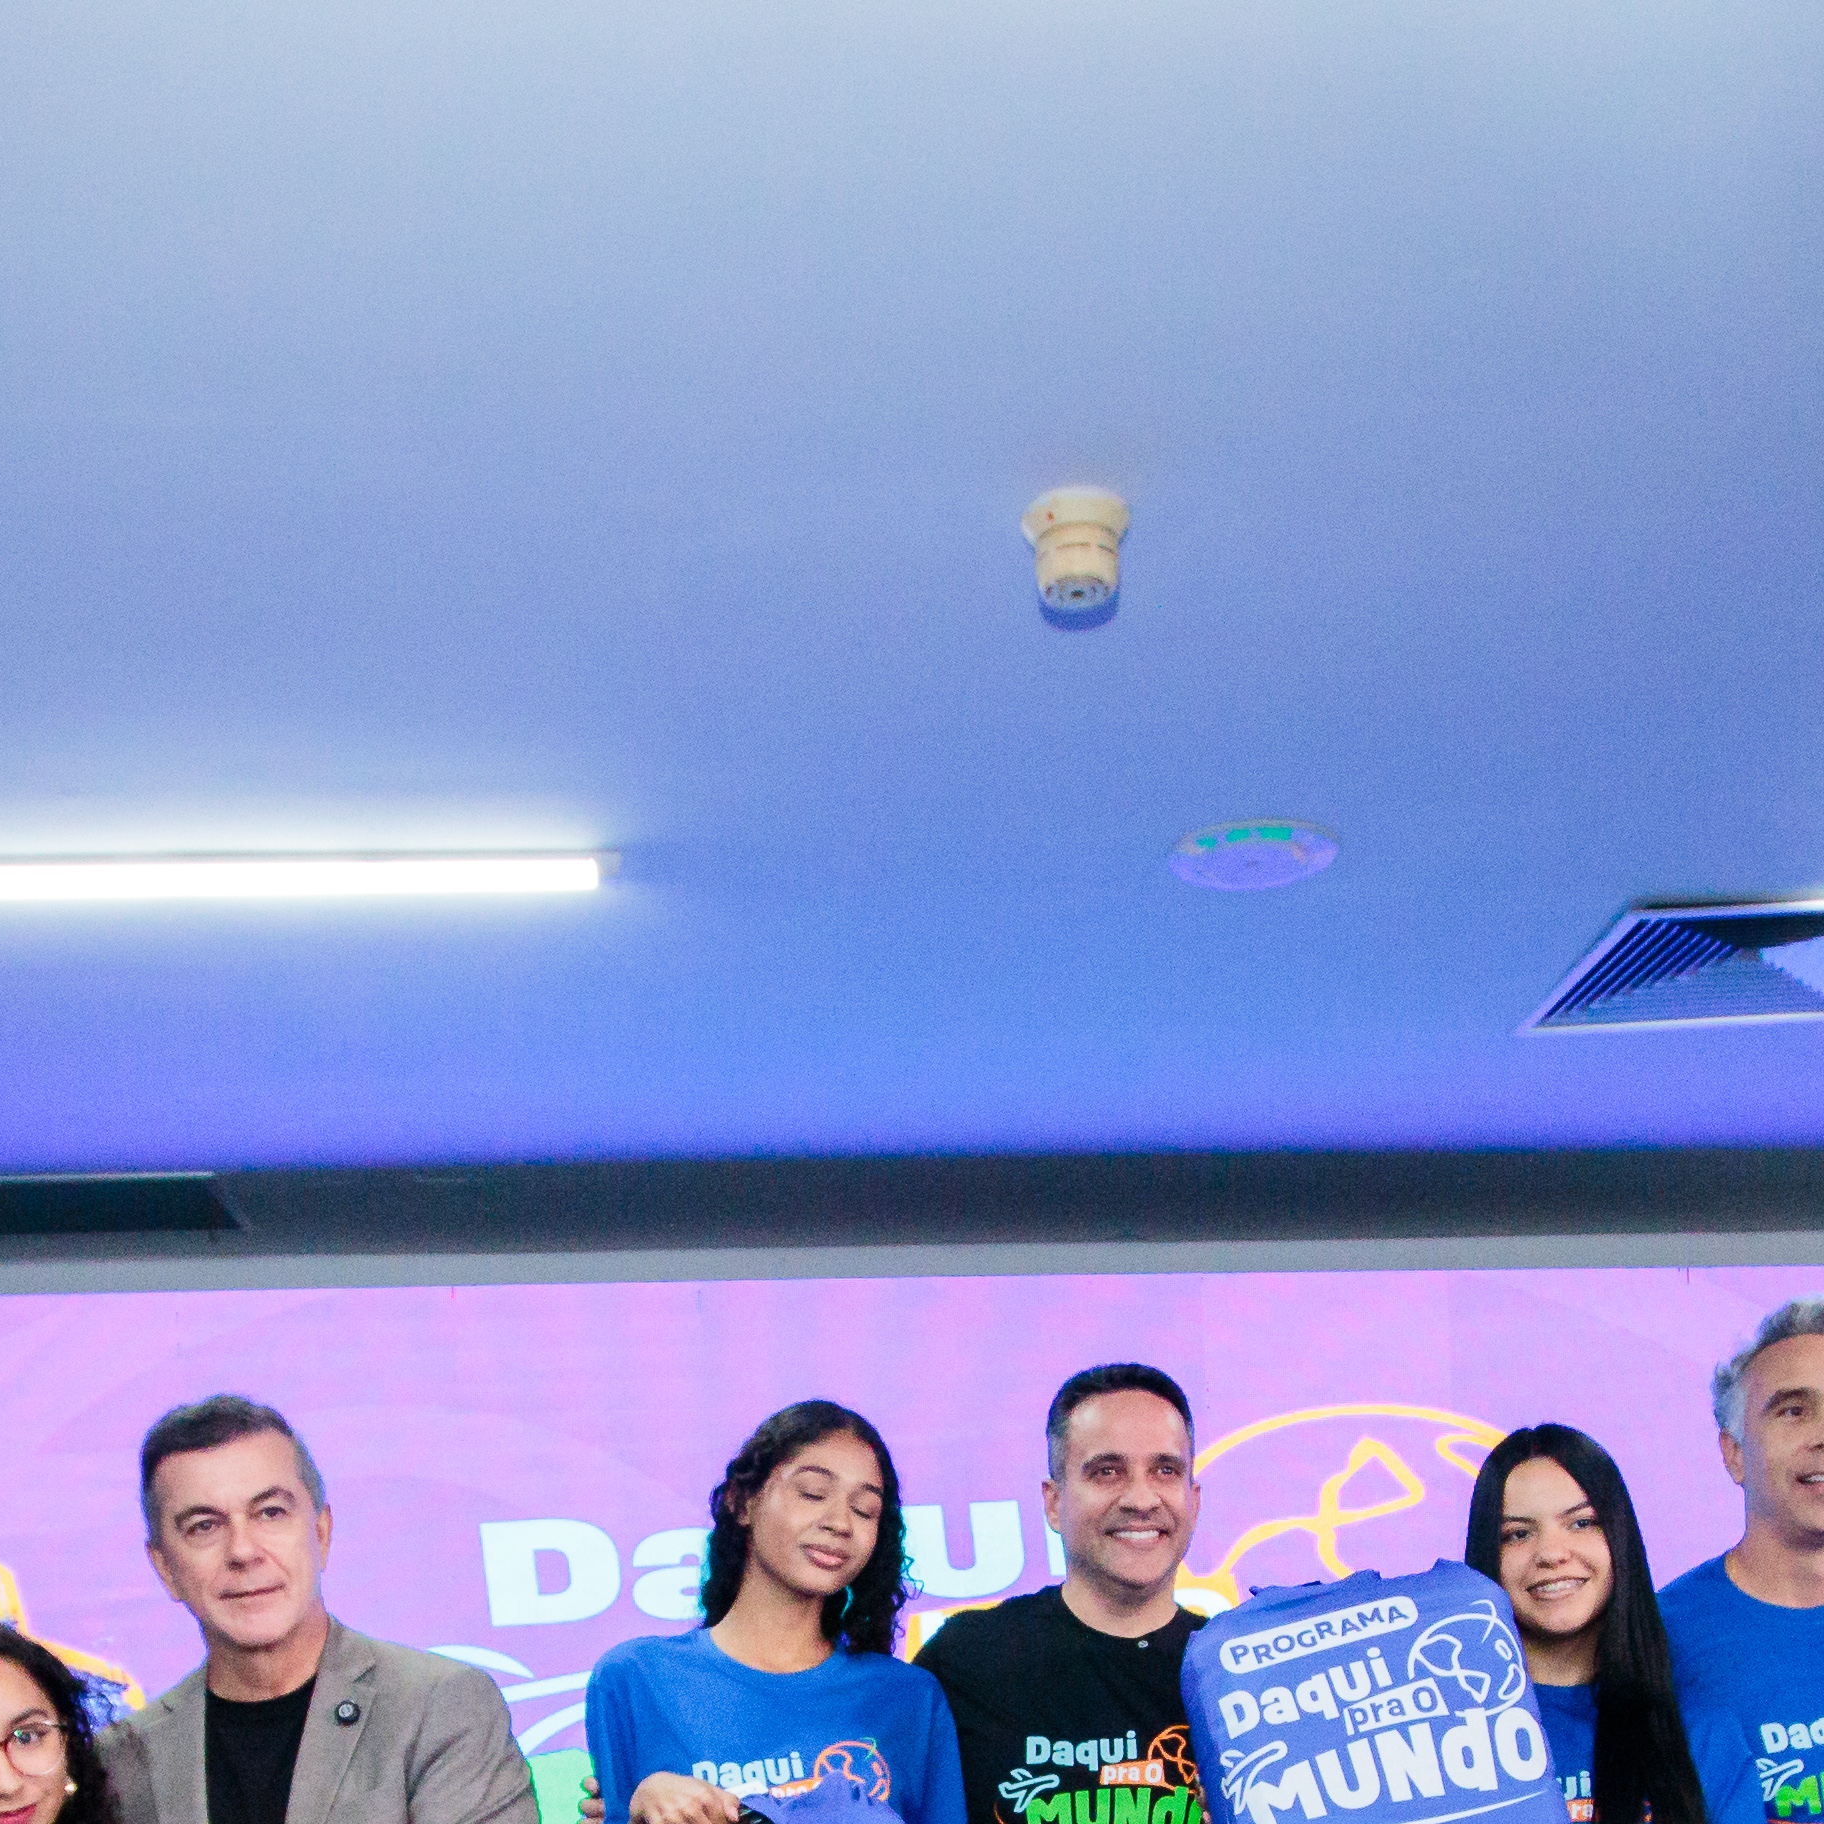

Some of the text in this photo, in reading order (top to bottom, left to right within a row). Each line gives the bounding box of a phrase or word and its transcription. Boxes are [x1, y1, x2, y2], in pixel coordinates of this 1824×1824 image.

[1229, 1604, 1410, 1666] PROGRAMA
[1347, 1695, 1406, 1735] pra
[1103, 1766, 1140, 1785] pra
